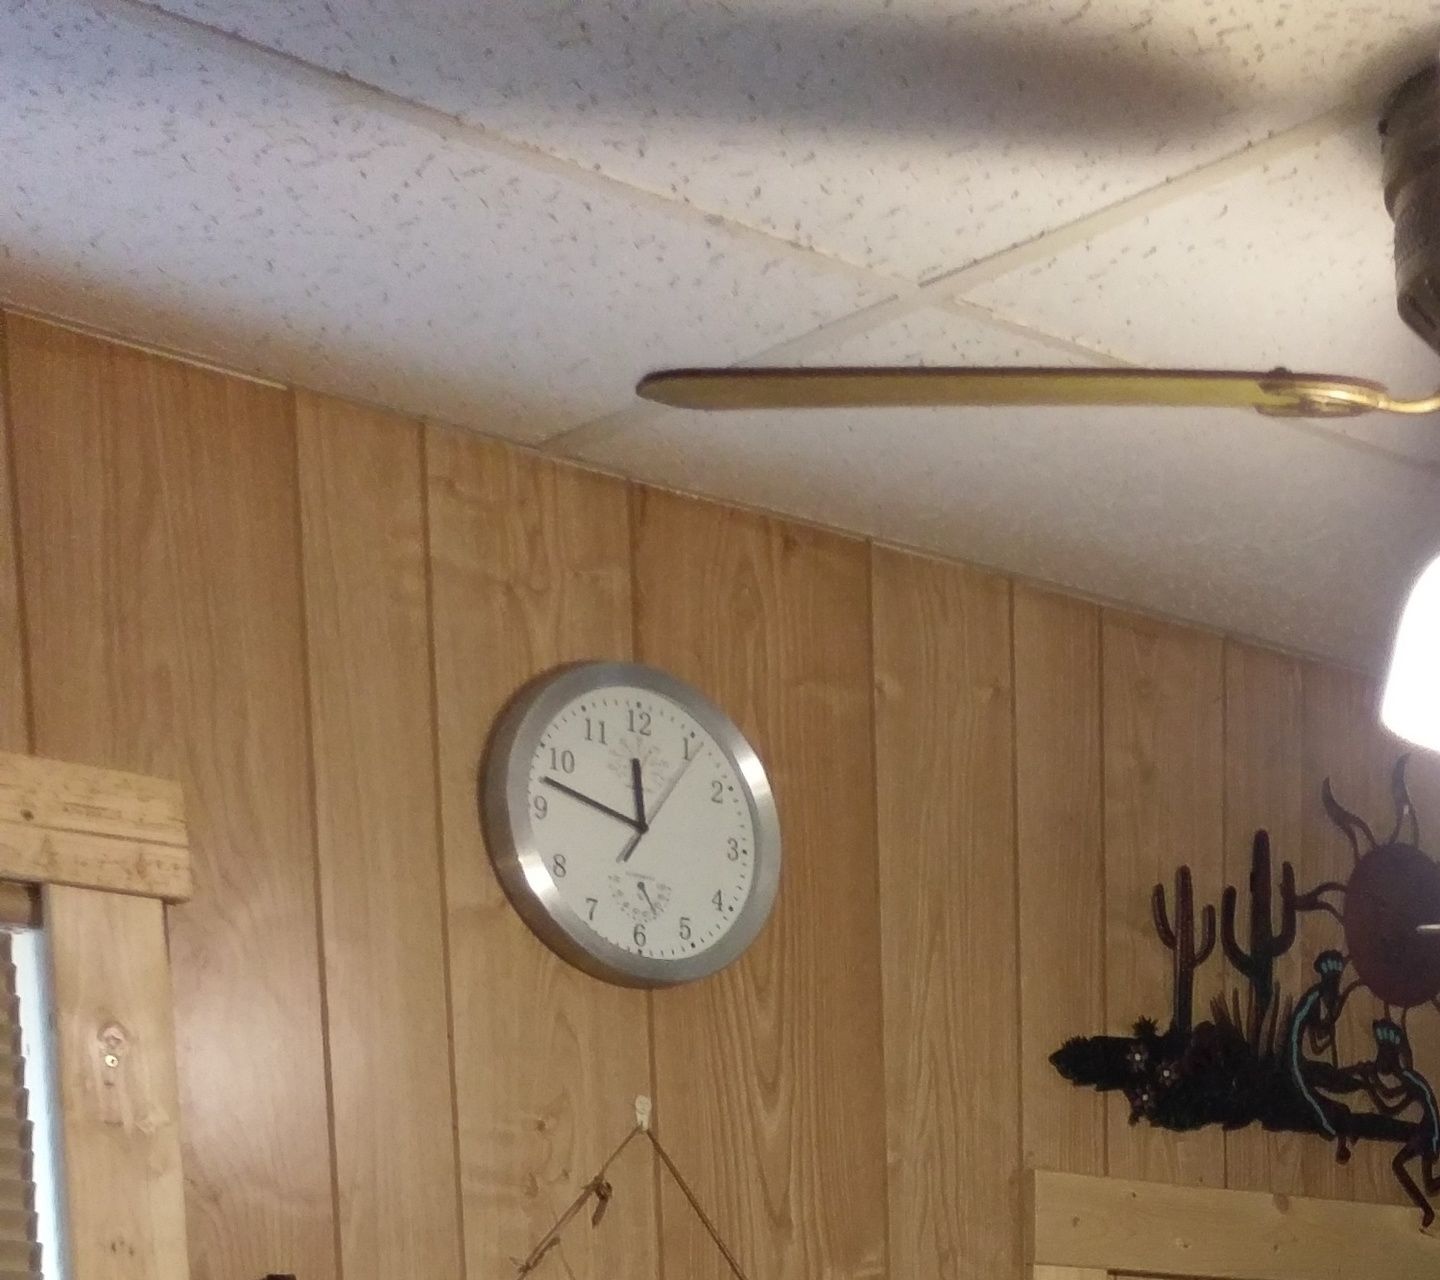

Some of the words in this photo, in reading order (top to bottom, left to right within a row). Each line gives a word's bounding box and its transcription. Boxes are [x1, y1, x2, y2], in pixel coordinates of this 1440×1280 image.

[584, 718, 607, 745] 11
[626, 709, 652, 736] 12
[681, 736, 692, 761] 1
[550, 748, 575, 774] 10
[711, 780, 724, 804] 2
[533, 797, 548, 820] 9
[726, 837, 740, 861] 3
[552, 854, 567, 878] 8
[585, 897, 599, 921] 7
[711, 888, 724, 913] 4
[632, 923, 647, 948] 6
[678, 917, 692, 941] 5
